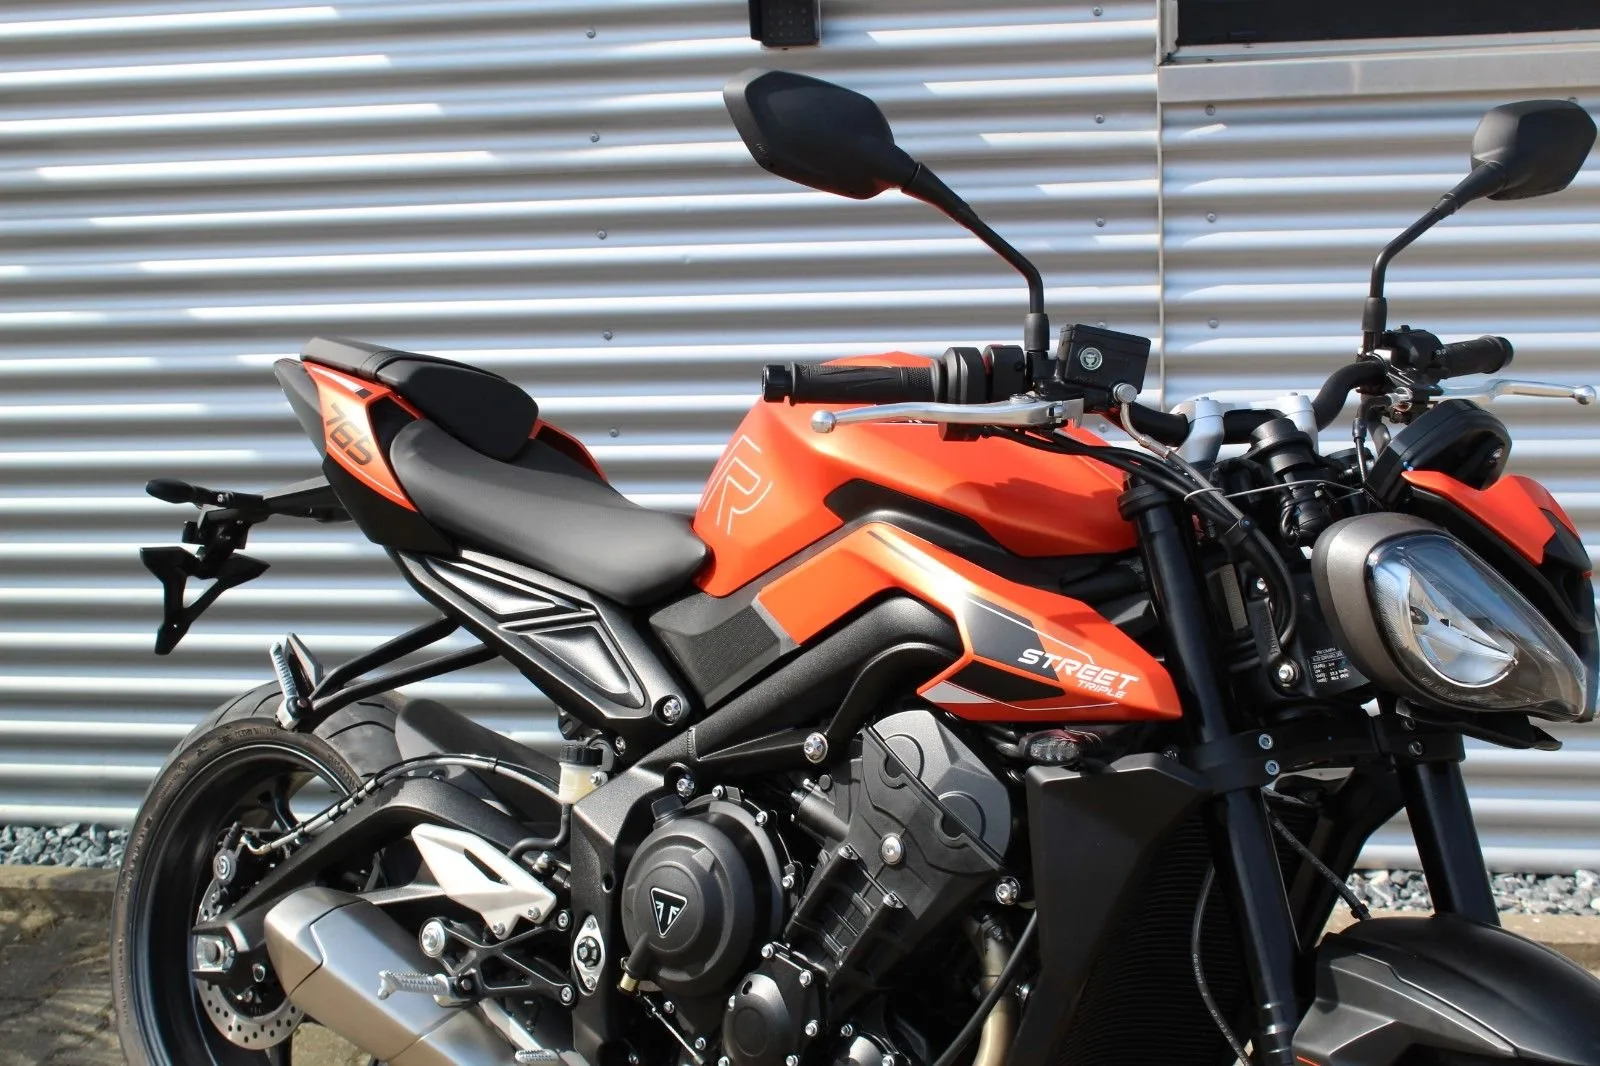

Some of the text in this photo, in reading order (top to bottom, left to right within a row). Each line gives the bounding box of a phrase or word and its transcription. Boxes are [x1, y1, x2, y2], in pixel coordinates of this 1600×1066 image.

[326, 403, 373, 466] 765
[1017, 648, 1139, 690] STREET
[1077, 679, 1127, 699] TRIPLE
